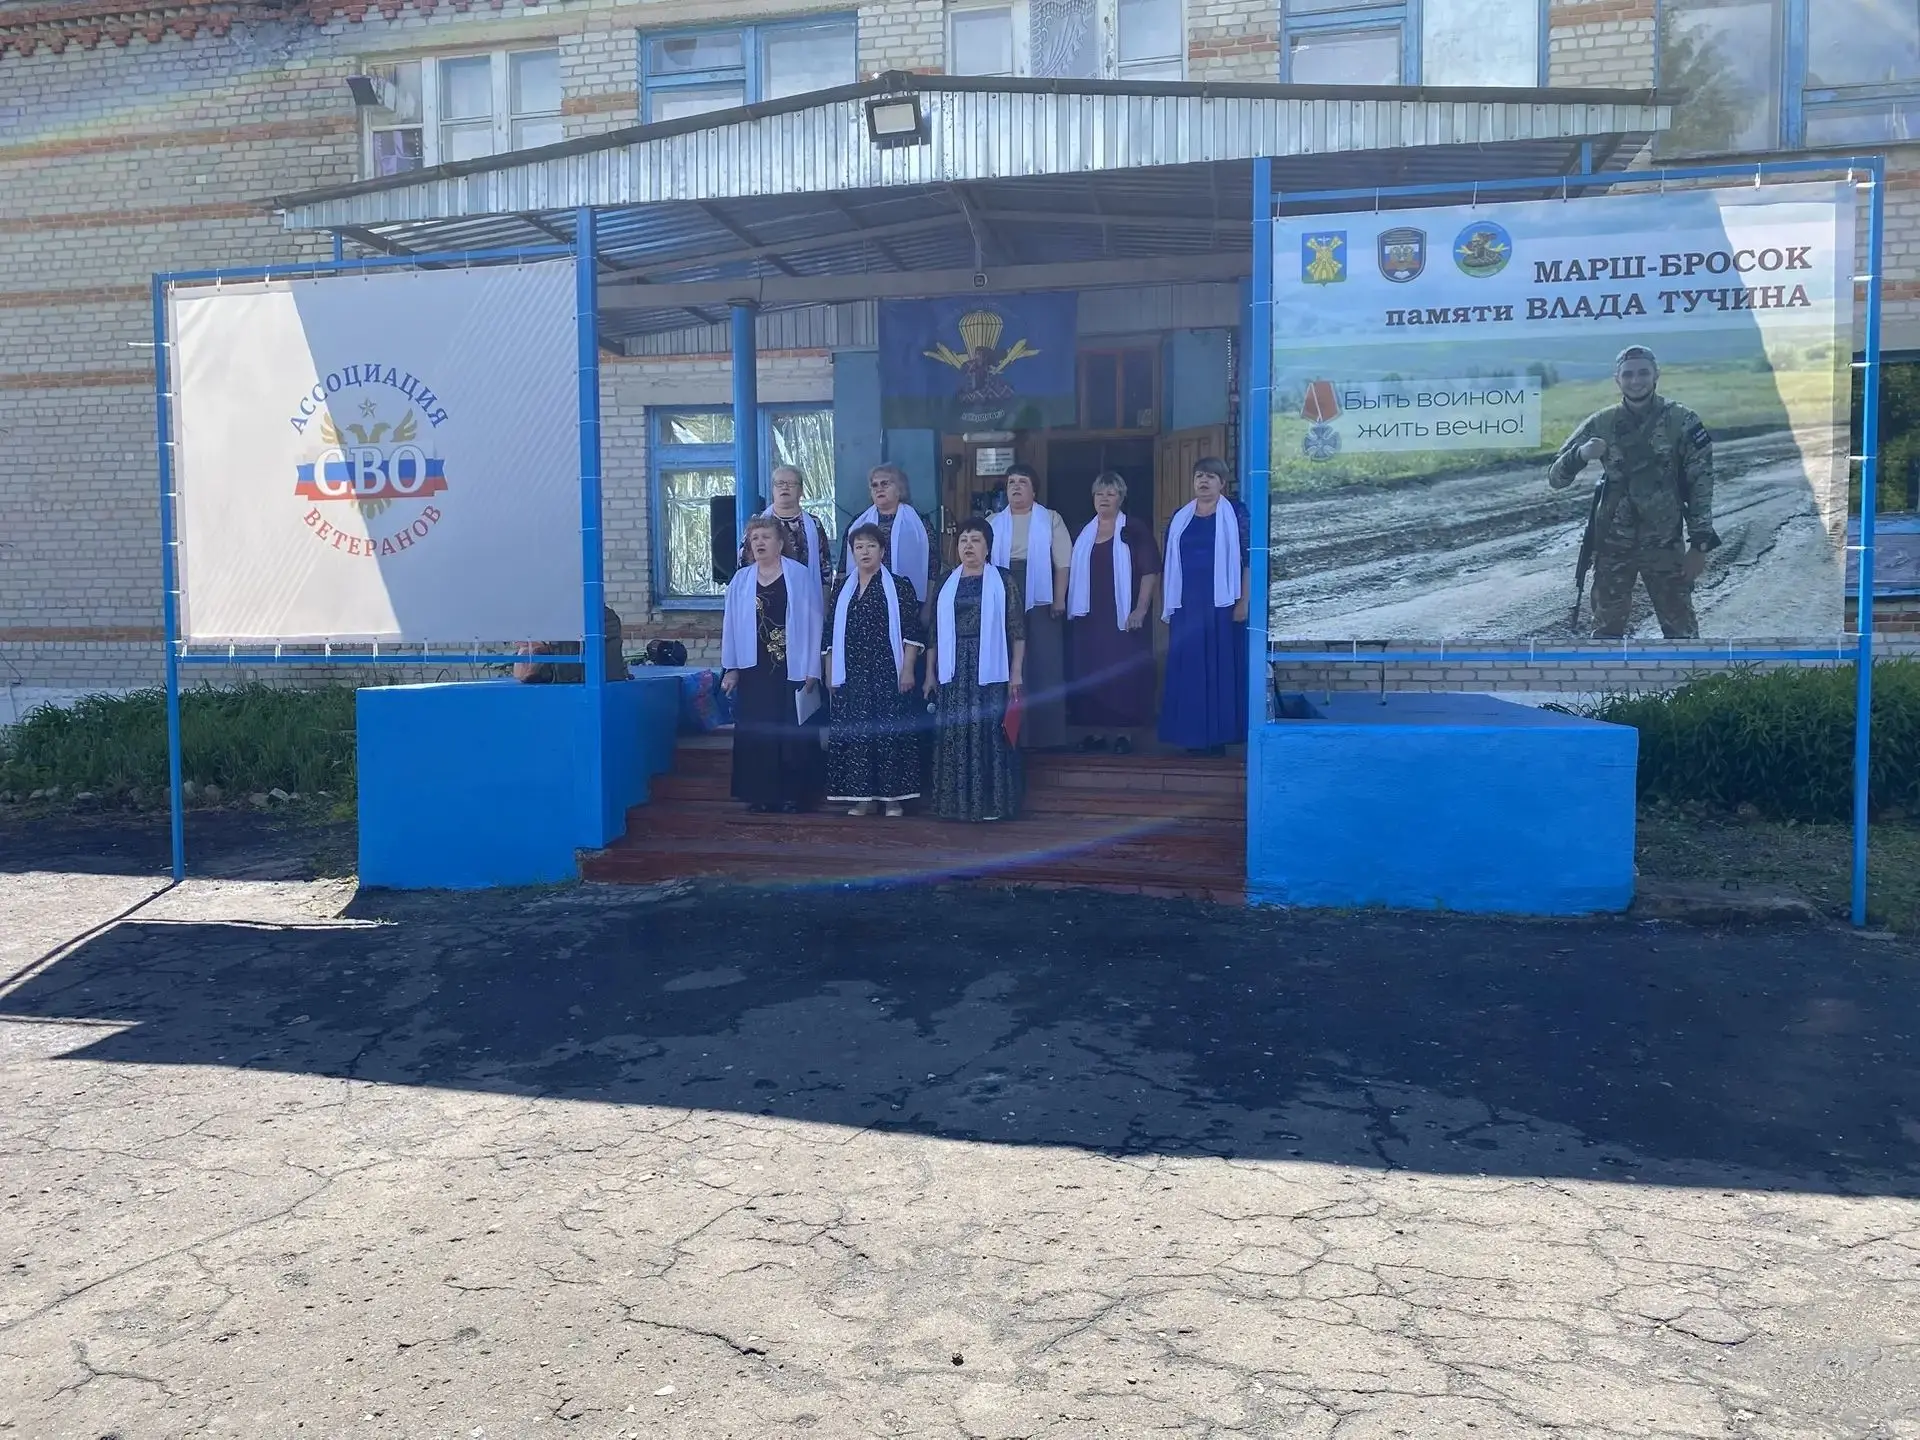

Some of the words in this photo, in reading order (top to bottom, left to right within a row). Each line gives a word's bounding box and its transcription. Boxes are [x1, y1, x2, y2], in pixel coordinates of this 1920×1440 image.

[1534, 246, 1812, 283] МАРШ-БРОСОК
[1386, 305, 1514, 326] памяти
[1526, 293, 1647, 321] ВЛАДА
[1657, 284, 1811, 314] ТУЧИНА
[290, 363, 448, 435] АССОЦИАЦИЯ
[1344, 390, 1411, 411] Быть
[1417, 389, 1525, 408] воином
[1358, 422, 1429, 439] жить
[1436, 415, 1524, 436] вечно!
[313, 444, 427, 496] СВО
[303, 505, 441, 557] ВЕТЕРАНОВ
